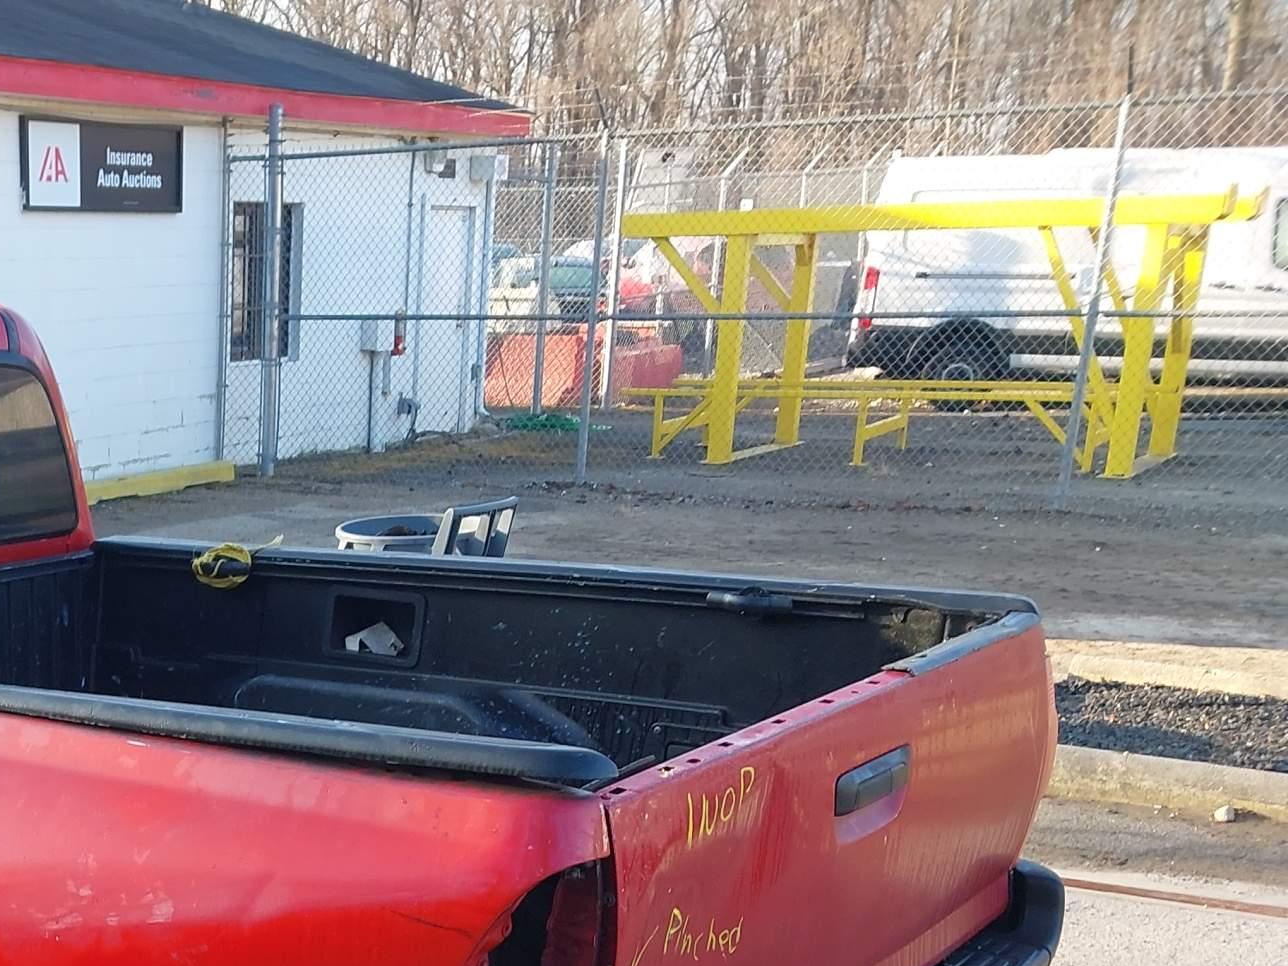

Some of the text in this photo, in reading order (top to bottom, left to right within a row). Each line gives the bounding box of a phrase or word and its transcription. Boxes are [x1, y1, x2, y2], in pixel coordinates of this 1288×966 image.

[106, 146, 153, 167] Insurance
[97, 168, 162, 189] Auto Auctions
